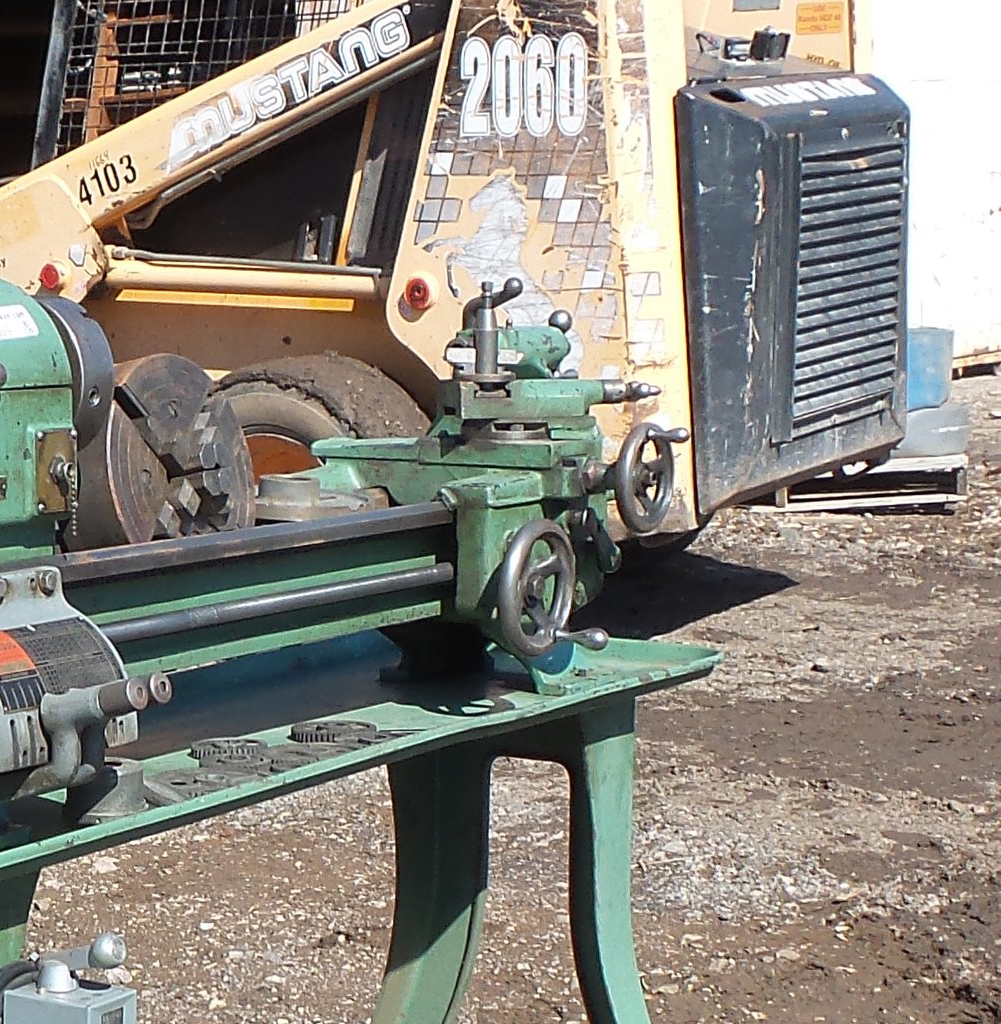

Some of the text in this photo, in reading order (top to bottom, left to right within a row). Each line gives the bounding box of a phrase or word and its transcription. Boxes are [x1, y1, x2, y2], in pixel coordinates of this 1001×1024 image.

[167, 7, 411, 174] MUSTANG
[460, 31, 589, 137] 2060
[79, 154, 137, 206] 4103
